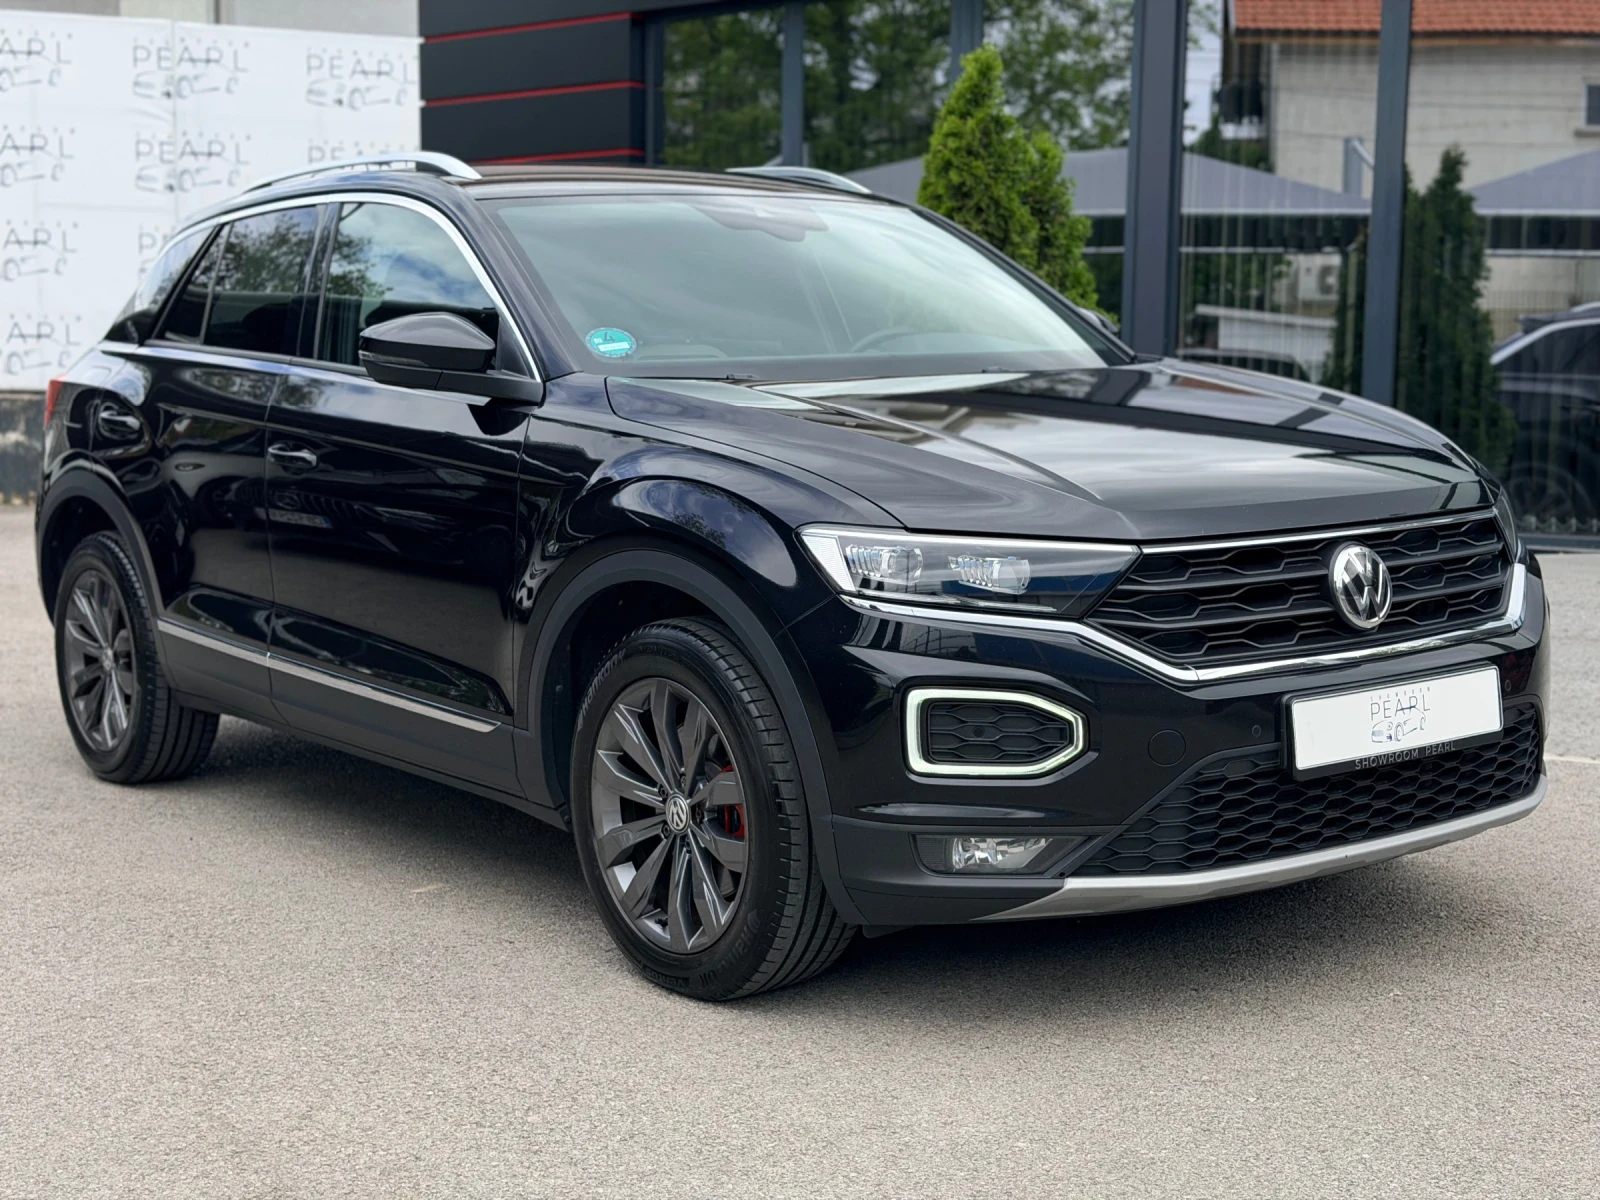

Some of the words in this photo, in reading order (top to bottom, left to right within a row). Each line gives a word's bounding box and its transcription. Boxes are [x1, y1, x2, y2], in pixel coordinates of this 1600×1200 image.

[132, 45, 249, 71] PEARL
[306, 53, 416, 85] PEARL
[135, 139, 250, 165] PEARL
[1370, 694, 1431, 721] PEARL
[1355, 748, 1419, 770] SHOWROOM
[1426, 740, 1456, 757] PEARL
